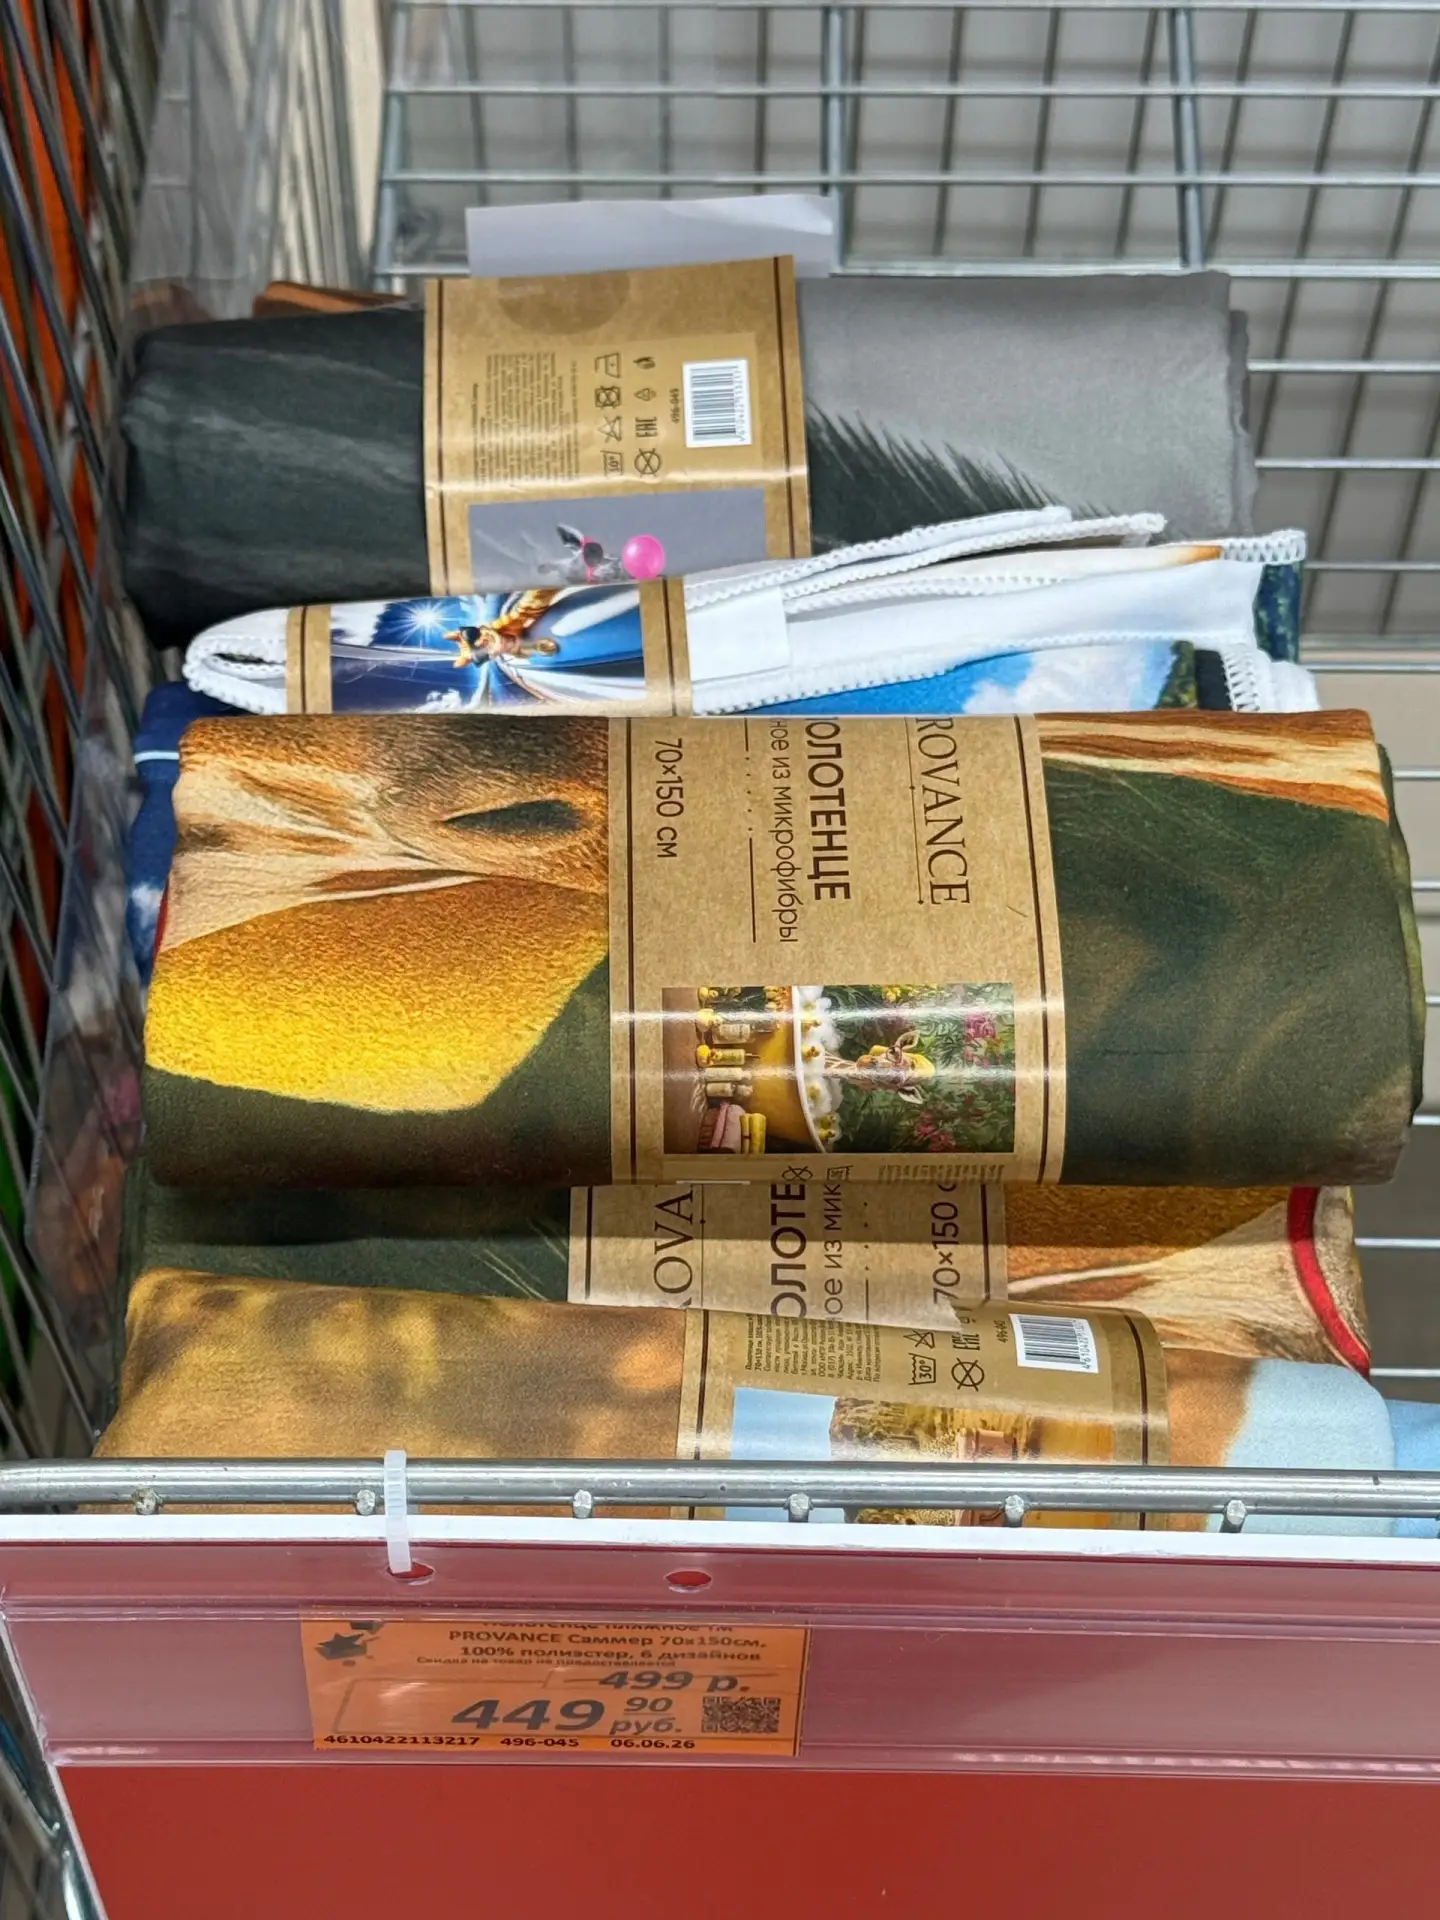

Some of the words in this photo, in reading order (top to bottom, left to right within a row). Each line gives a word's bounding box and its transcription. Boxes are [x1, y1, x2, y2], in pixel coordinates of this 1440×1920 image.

[772, 757, 792, 780] из
[805, 718, 850, 900] ОЛОТЕНЦЕ
[656, 826, 679, 859] см
[768, 787, 803, 943] микрофибры
[653, 1184, 692, 1311] OVA
[823, 1240, 843, 1268] из
[823, 1279, 843, 1321] ое
[448, 1630, 562, 1643] PROVANCE
[567, 1634, 653, 1647] Саммер
[459, 1646, 515, 1656] 100%
[640, 1650, 653, 1659] 6
[657, 1651, 761, 1661] дизайнов
[598, 1671, 694, 1690] 499
[451, 1699, 605, 1730] 449
[623, 1696, 673, 1712] 90
[609, 1716, 682, 1735] руб.
[323, 1735, 480, 1747] 4610422113217
[499, 1738, 580, 1748] 496-045
[610, 1737, 695, 1749] 06.06.26
